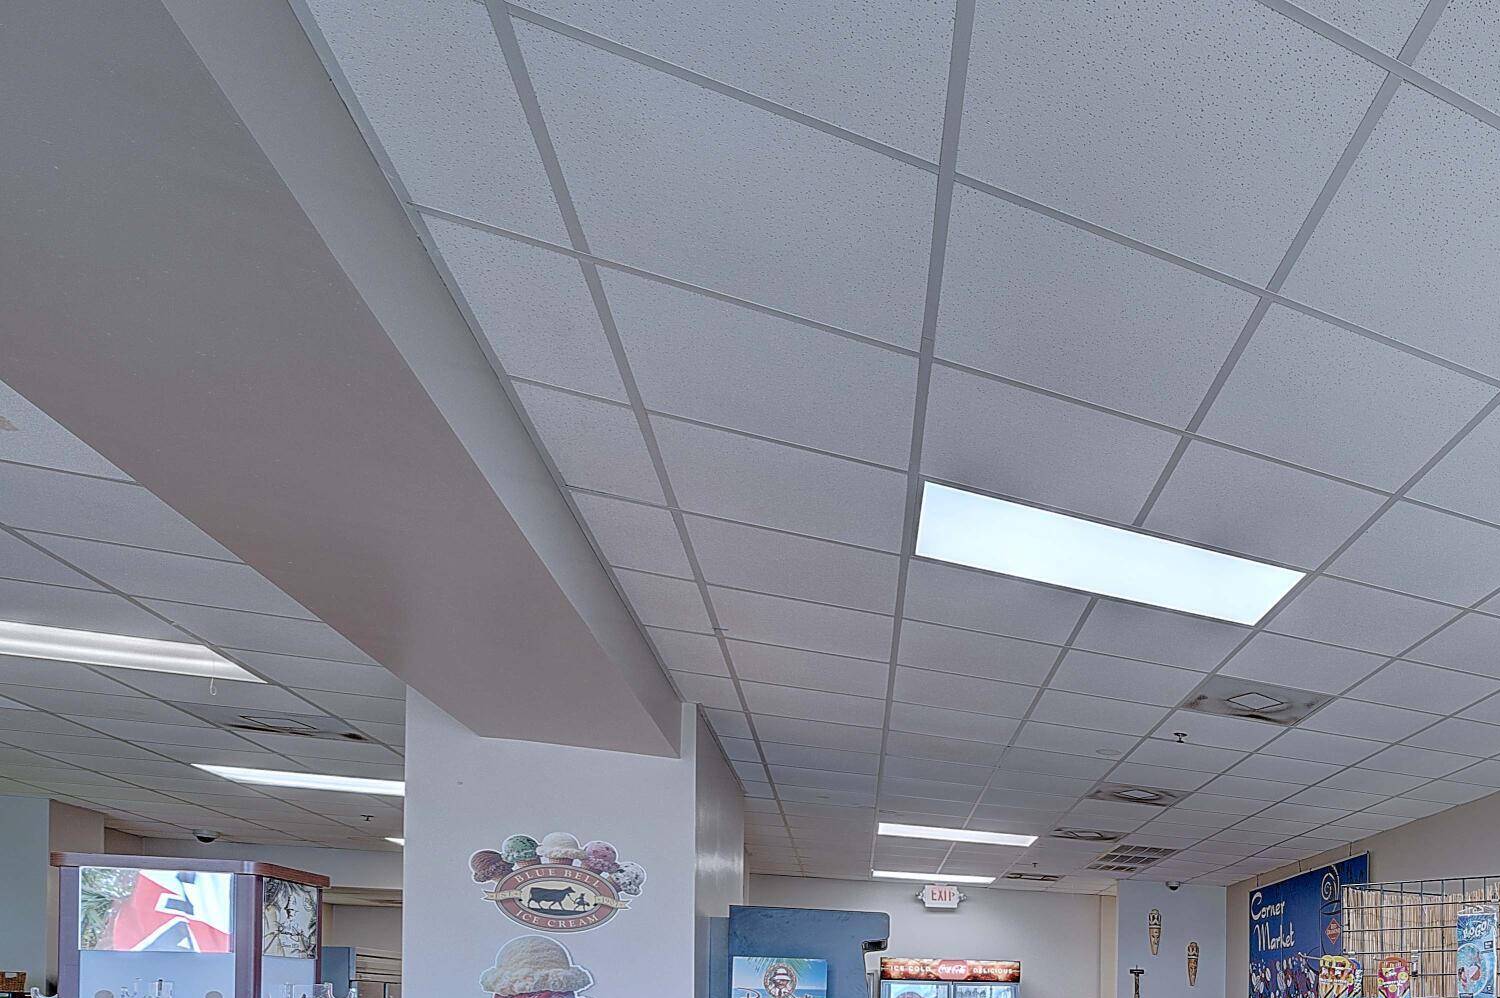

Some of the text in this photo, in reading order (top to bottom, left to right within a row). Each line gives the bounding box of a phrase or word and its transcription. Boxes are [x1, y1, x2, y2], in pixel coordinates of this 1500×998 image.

[514, 868, 601, 888] BLUE BELL
[931, 889, 955, 902] EXIT
[1250, 891, 1286, 921] Corner
[515, 910, 600, 929] ICE CREAM
[1254, 921, 1296, 952] Market
[908, 965, 931, 973] COLD
[973, 967, 1013, 975] DELICIOUS
